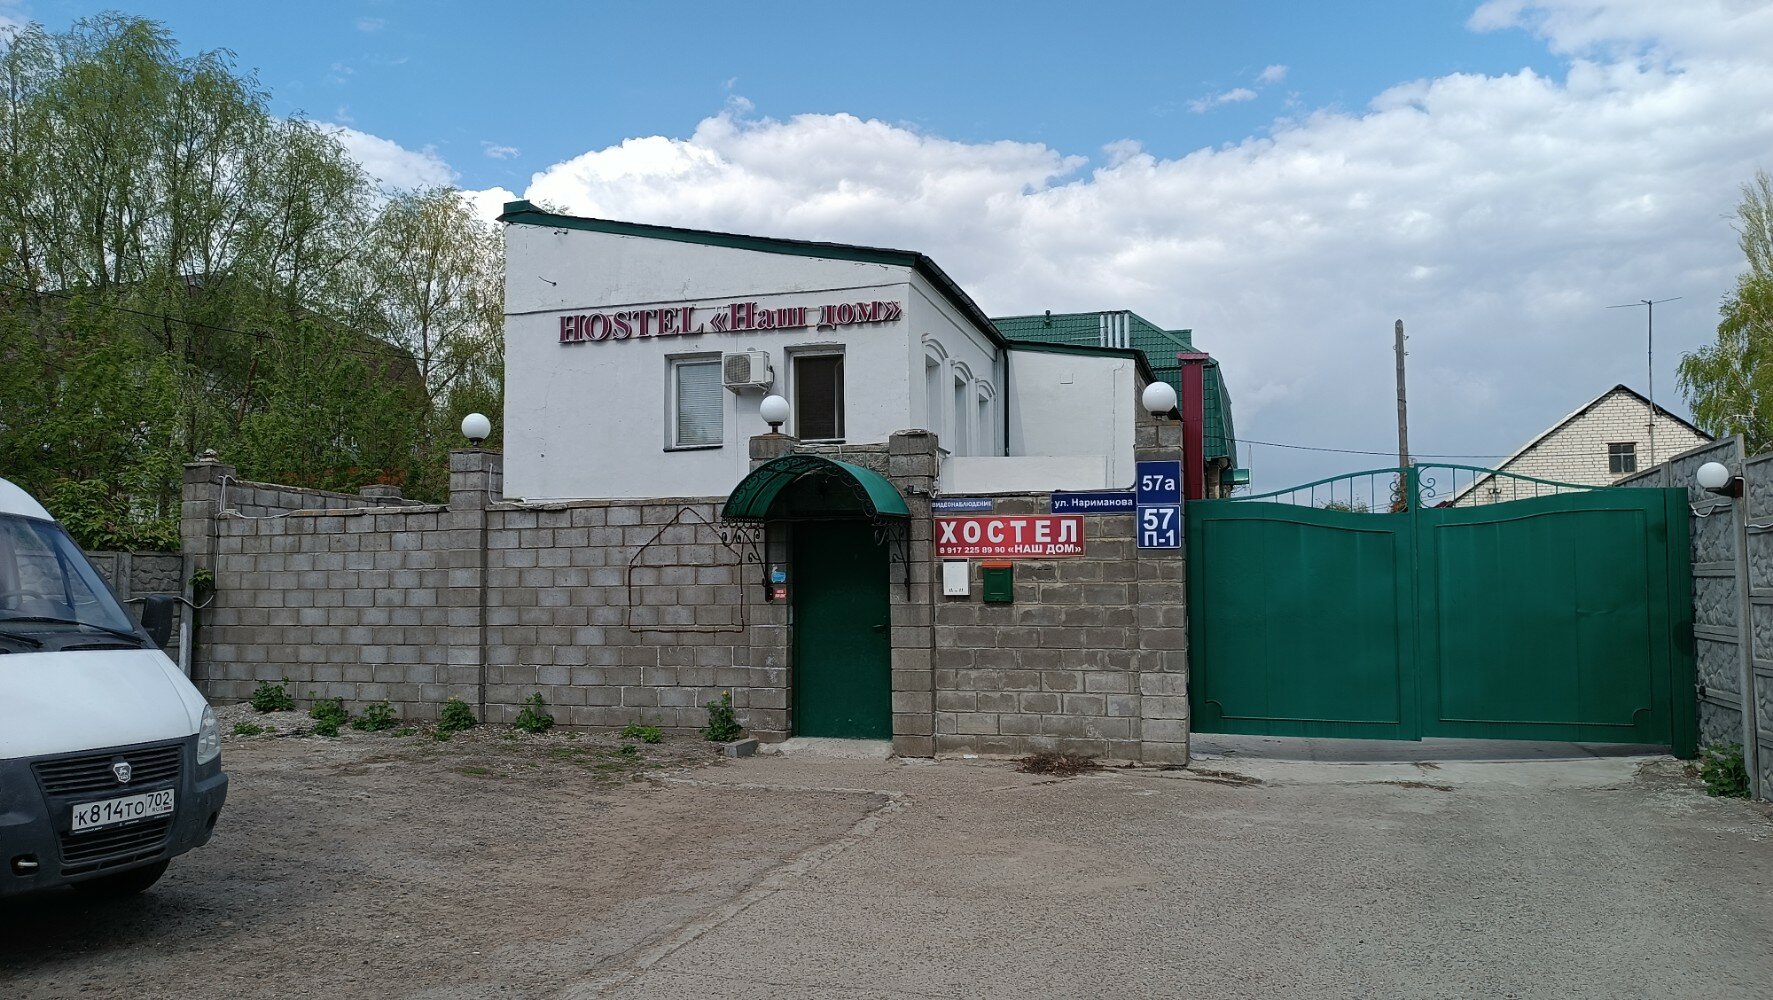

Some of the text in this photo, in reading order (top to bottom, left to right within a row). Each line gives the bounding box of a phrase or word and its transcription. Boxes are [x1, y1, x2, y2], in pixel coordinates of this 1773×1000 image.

[559, 300, 902, 343] HOSTEL «Наш дом»
[1142, 475, 1176, 491] 57а
[1054, 498, 1133, 508] ул. Нариманова
[1143, 508, 1174, 530] 57
[940, 520, 1077, 543] ХОСТЕЛ
[1144, 530, 1175, 547] П-1
[964, 546, 980, 554] 225
[1008, 544, 1043, 553] «НАШ
[1045, 544, 1082, 554] ДОМ»
[147, 792, 170, 808] 702
